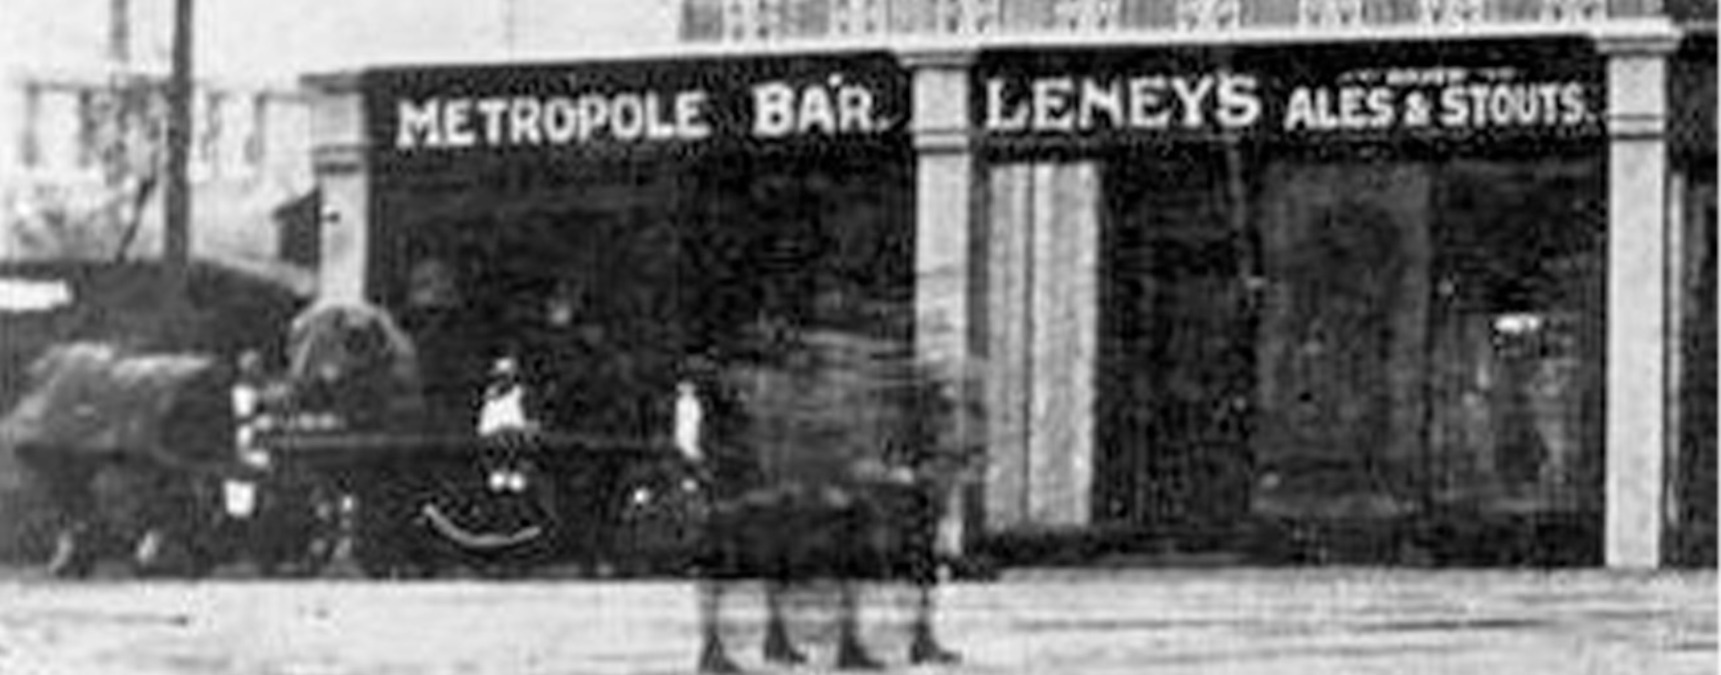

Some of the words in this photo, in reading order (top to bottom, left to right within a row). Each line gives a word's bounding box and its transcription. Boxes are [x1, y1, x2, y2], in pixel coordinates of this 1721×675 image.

[396, 91, 708, 148] METROPOLE
[1285, 86, 1394, 131] ALES
[1404, 90, 1430, 127] &
